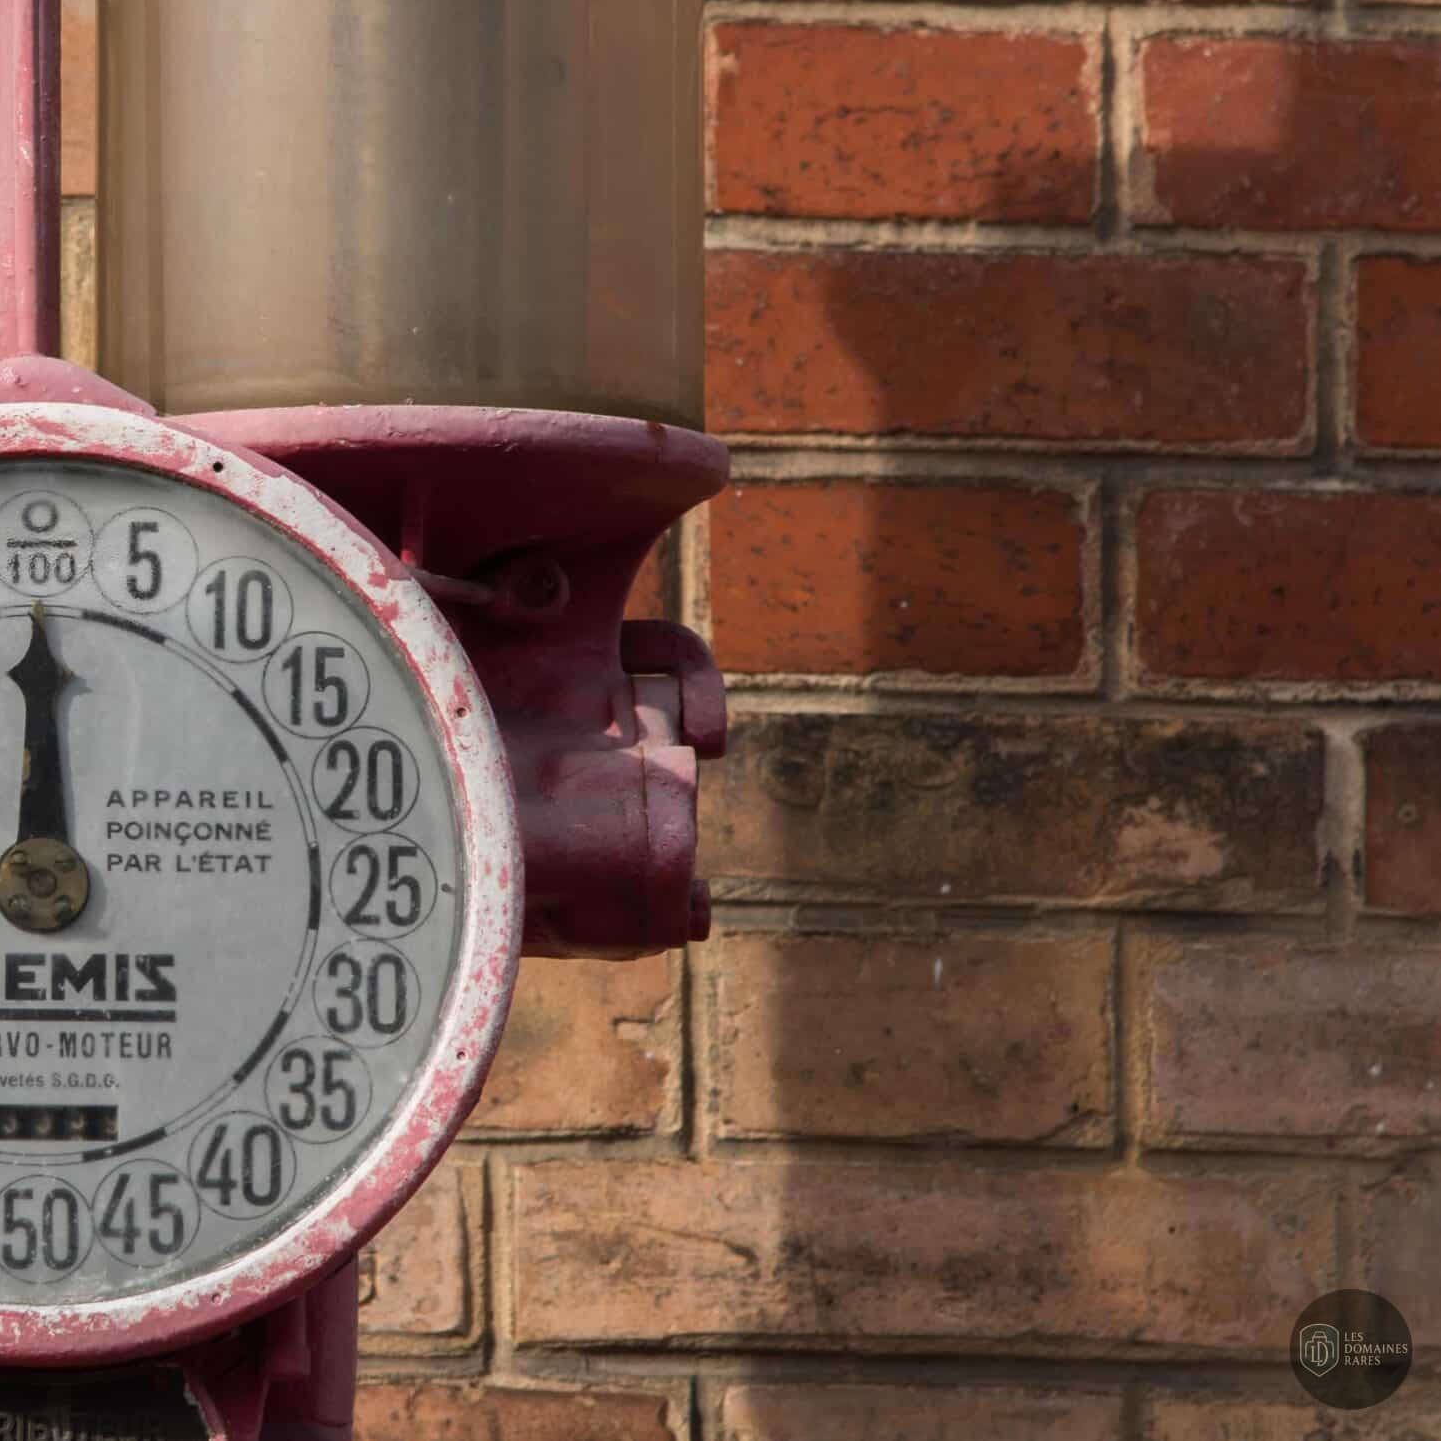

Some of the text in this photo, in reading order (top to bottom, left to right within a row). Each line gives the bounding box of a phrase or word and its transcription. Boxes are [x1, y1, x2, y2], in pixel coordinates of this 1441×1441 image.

[7, 552, 76, 584] 100
[125, 521, 162, 600] 5
[205, 569, 273, 651] 10
[281, 645, 348, 727] 15
[106, 789, 274, 808] APPAREIL
[325, 739, 403, 821] 20
[106, 820, 272, 846] POINÇONNÉ
[107, 850, 272, 873] PAR L'ÉTAT
[346, 844, 422, 926] 25
[326, 952, 407, 1035] 30
[51, 1072, 120, 1088] S.G.D.G.
[279, 1048, 357, 1132] 35
[197, 1123, 283, 1207] 40
[2, 1188, 79, 1271] 50
[99, 1172, 184, 1256] 45
